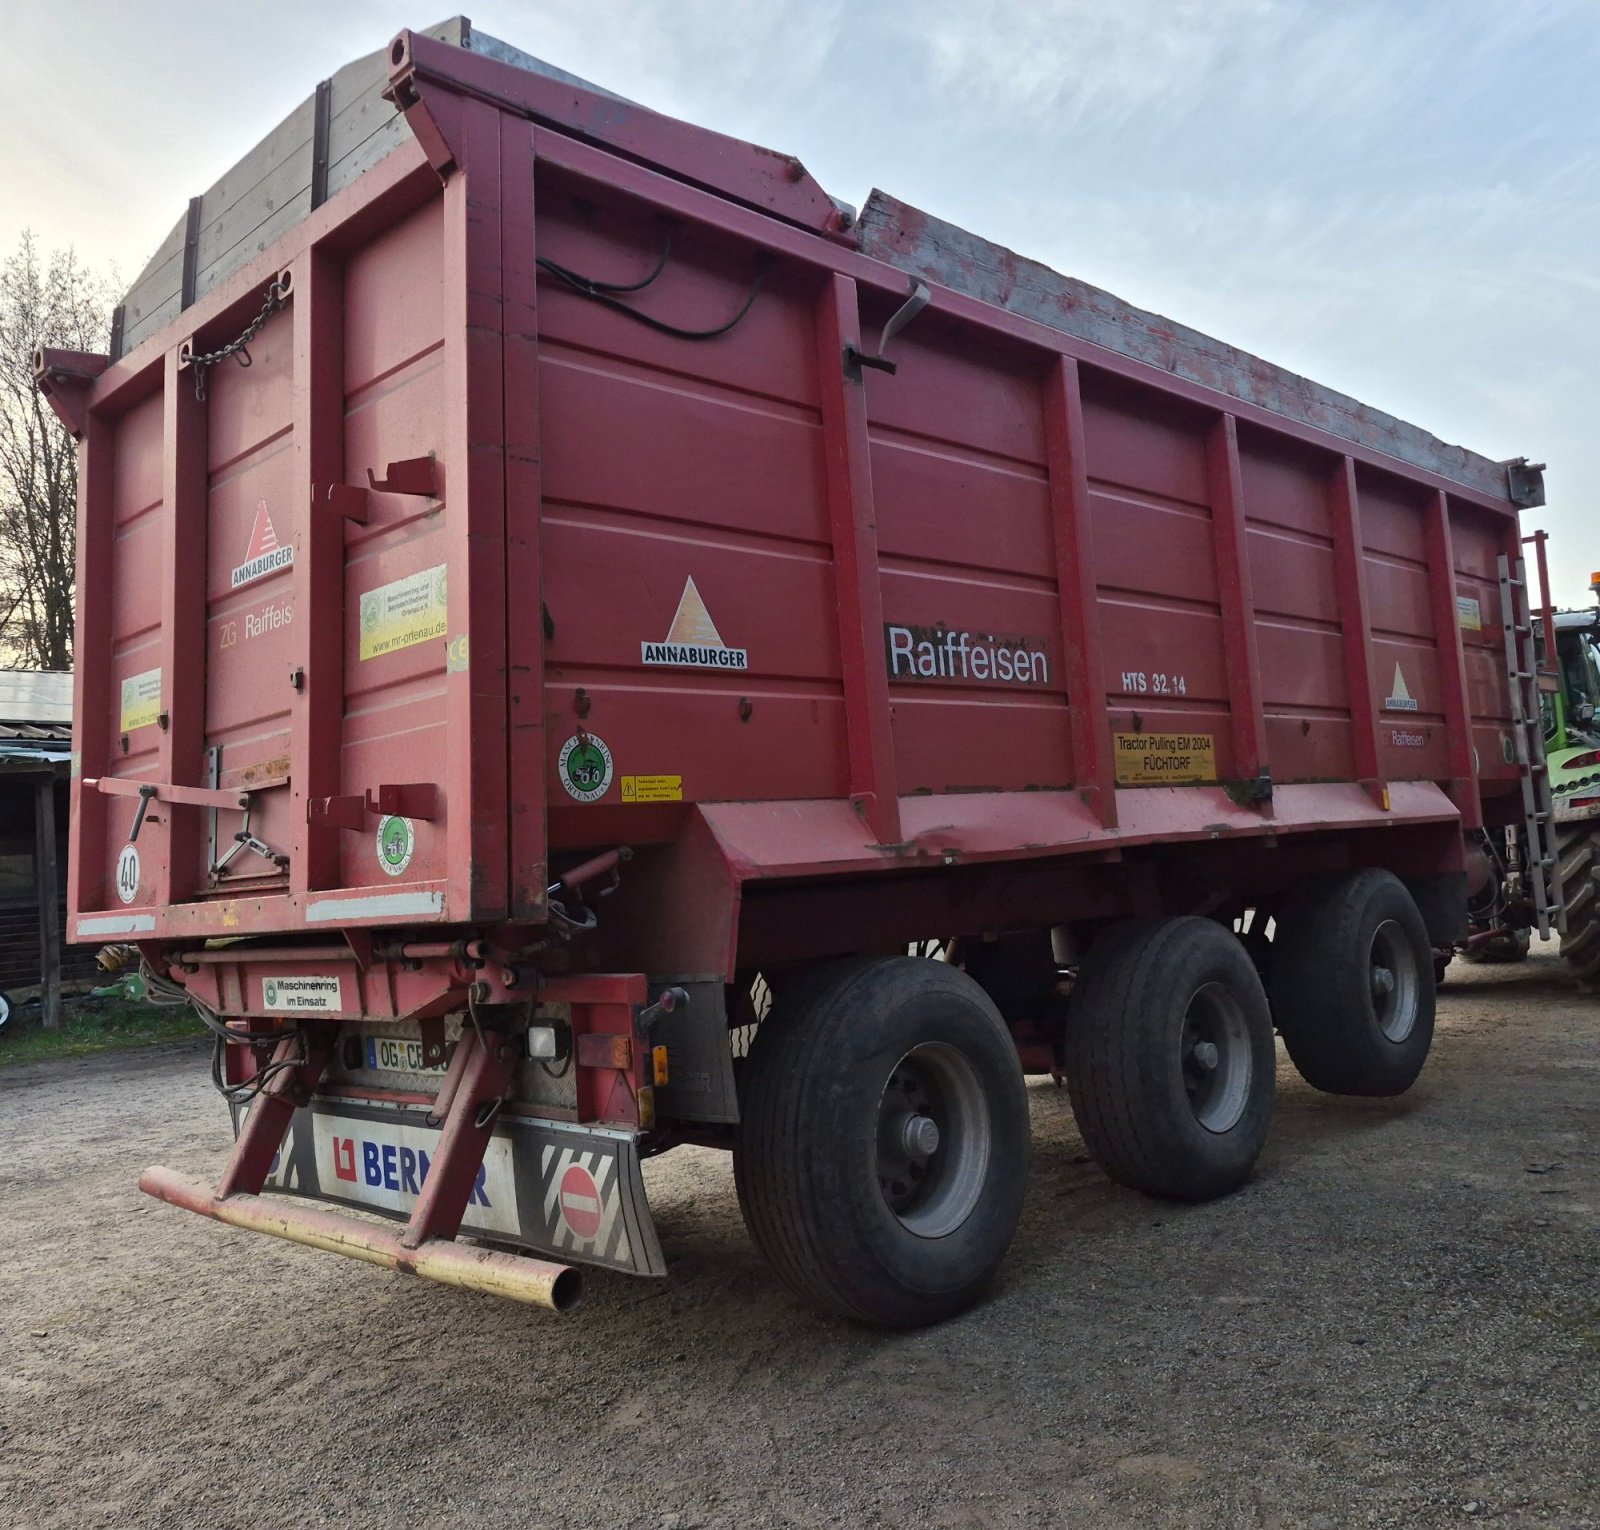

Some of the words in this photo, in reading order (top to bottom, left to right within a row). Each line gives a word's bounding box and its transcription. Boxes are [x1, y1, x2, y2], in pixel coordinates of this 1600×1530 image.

[233, 547, 292, 585] ANNABURGER
[220, 622, 237, 649] ZG
[246, 601, 294, 639] Raiffeis
[645, 645, 745, 667] ANNABURGER
[889, 627, 1048, 683] Raiffeisen
[1122, 672, 1147, 693] HTS
[1118, 736, 1147, 750] Tractor
[1149, 737, 1176, 753] Pulling
[1178, 737, 1190, 750] EM
[1192, 738, 1211, 751] 2004
[1144, 754, 1191, 770] FÜCHTORF
[121, 855, 136, 891] 40
[277, 980, 338, 992] Maschinenring
[287, 996, 296, 1006] im
[297, 996, 327, 1006] Einsatz
[381, 1041, 399, 1067] OG
